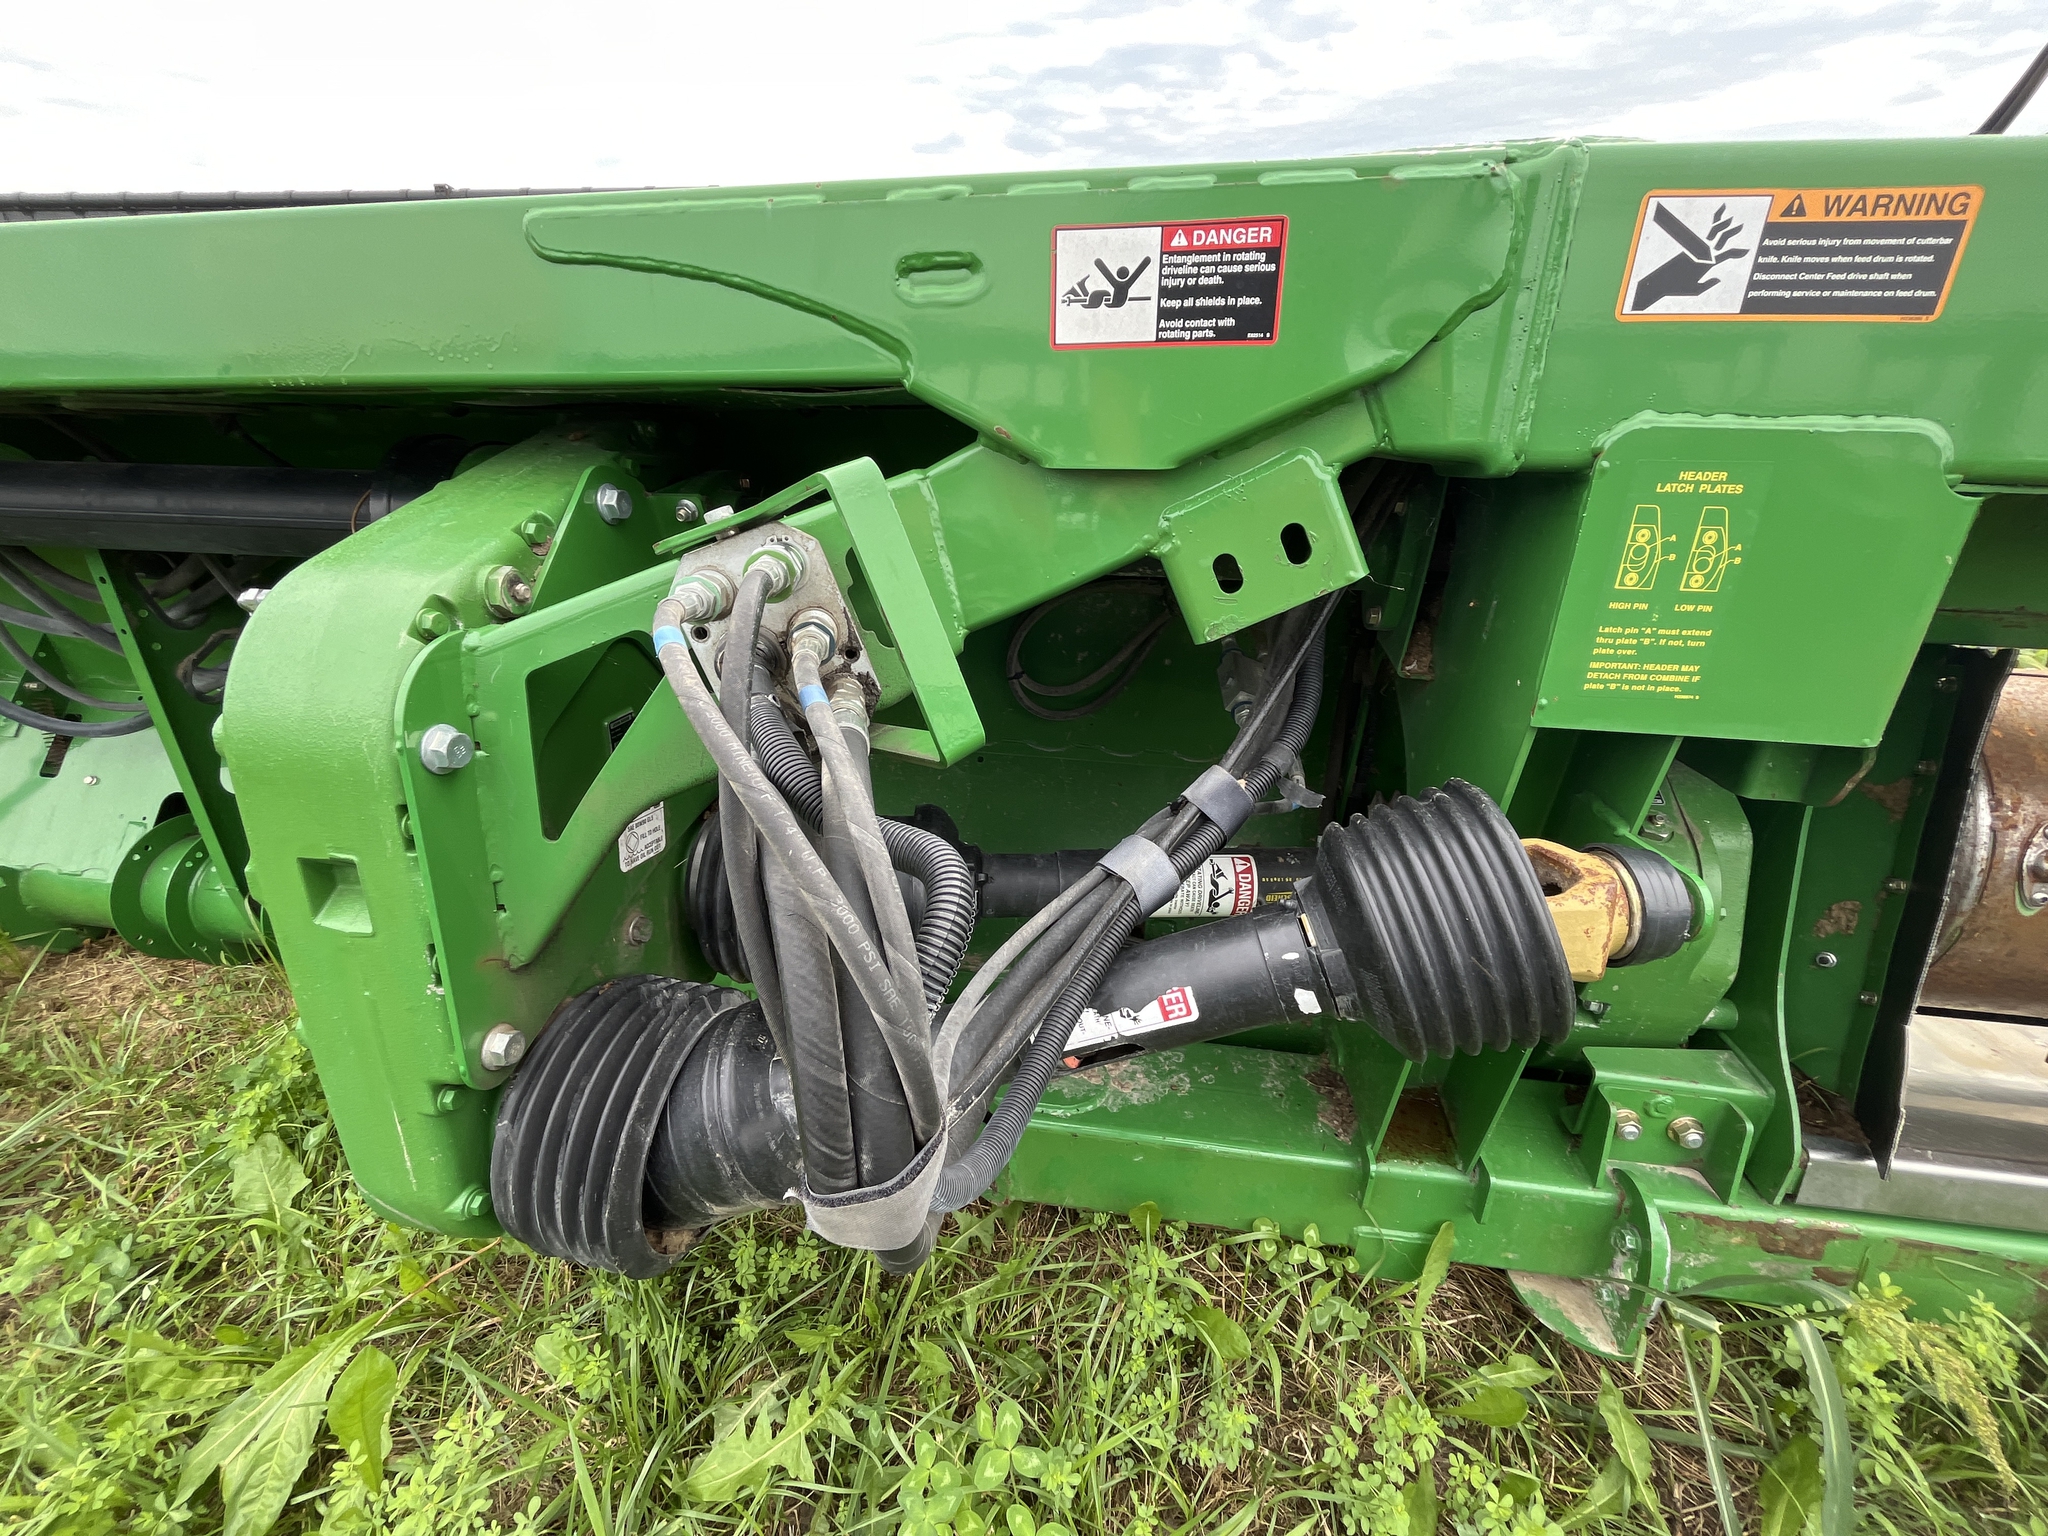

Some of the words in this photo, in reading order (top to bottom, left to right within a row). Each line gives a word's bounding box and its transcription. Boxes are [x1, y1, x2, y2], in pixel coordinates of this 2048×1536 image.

[1823, 192, 1971, 217] WARNING
[1193, 226, 1272, 246] DANGER
[1818, 238, 1841, 247] injury
[1863, 237, 1905, 245] movement
[1906, 237, 1917, 245] of
[1916, 237, 1953, 245] cutterbar
[1162, 252, 1221, 265] Entanglement
[1223, 252, 1231, 261] in
[1233, 250, 1266, 263] rotating
[1161, 265, 1198, 275] driveline
[1200, 266, 1215, 274] can
[1217, 265, 1243, 273] cause
[1244, 262, 1276, 272] serious
[1799, 272, 1825, 280] Center
[1826, 272, 1847, 280] Feed
[1847, 272, 1868, 280] drive
[1869, 272, 1890, 280] shaft
[1890, 272, 1912, 280] when
[1161, 277, 1185, 288] injury
[1187, 277, 1197, 285] or
[1198, 275, 1224, 285] death.
[1748, 290, 1791, 298] performing
[1160, 298, 1181, 309] Keep
[1183, 297, 1194, 306] all
[1195, 296, 1226, 306] shields
[1227, 296, 1235, 305] in
[1237, 296, 1262, 307] place.
[1159, 319, 1183, 328] Avoid
[1185, 318, 1216, 327] contact
[1218, 317, 1235, 326] with
[1158, 329, 1192, 340] rotating
[1192, 328, 1216, 339] parts.
[1679, 471, 1727, 481] HEADER
[1656, 483, 1694, 493] LATCH
[1699, 484, 1743, 494] PLATES
[1609, 602, 1631, 610] HIGH
[1674, 604, 1695, 612] LOW
[1624, 627, 1639, 635] pin
[1593, 647, 1615, 655] plate
[1590, 662, 1641, 670] IMPORTANT:
[1649, 674, 1690, 682] COMBINE
[1584, 682, 1604, 690] plate
[858, 940, 881, 972] PSI
[879, 978, 901, 1011] SAE
